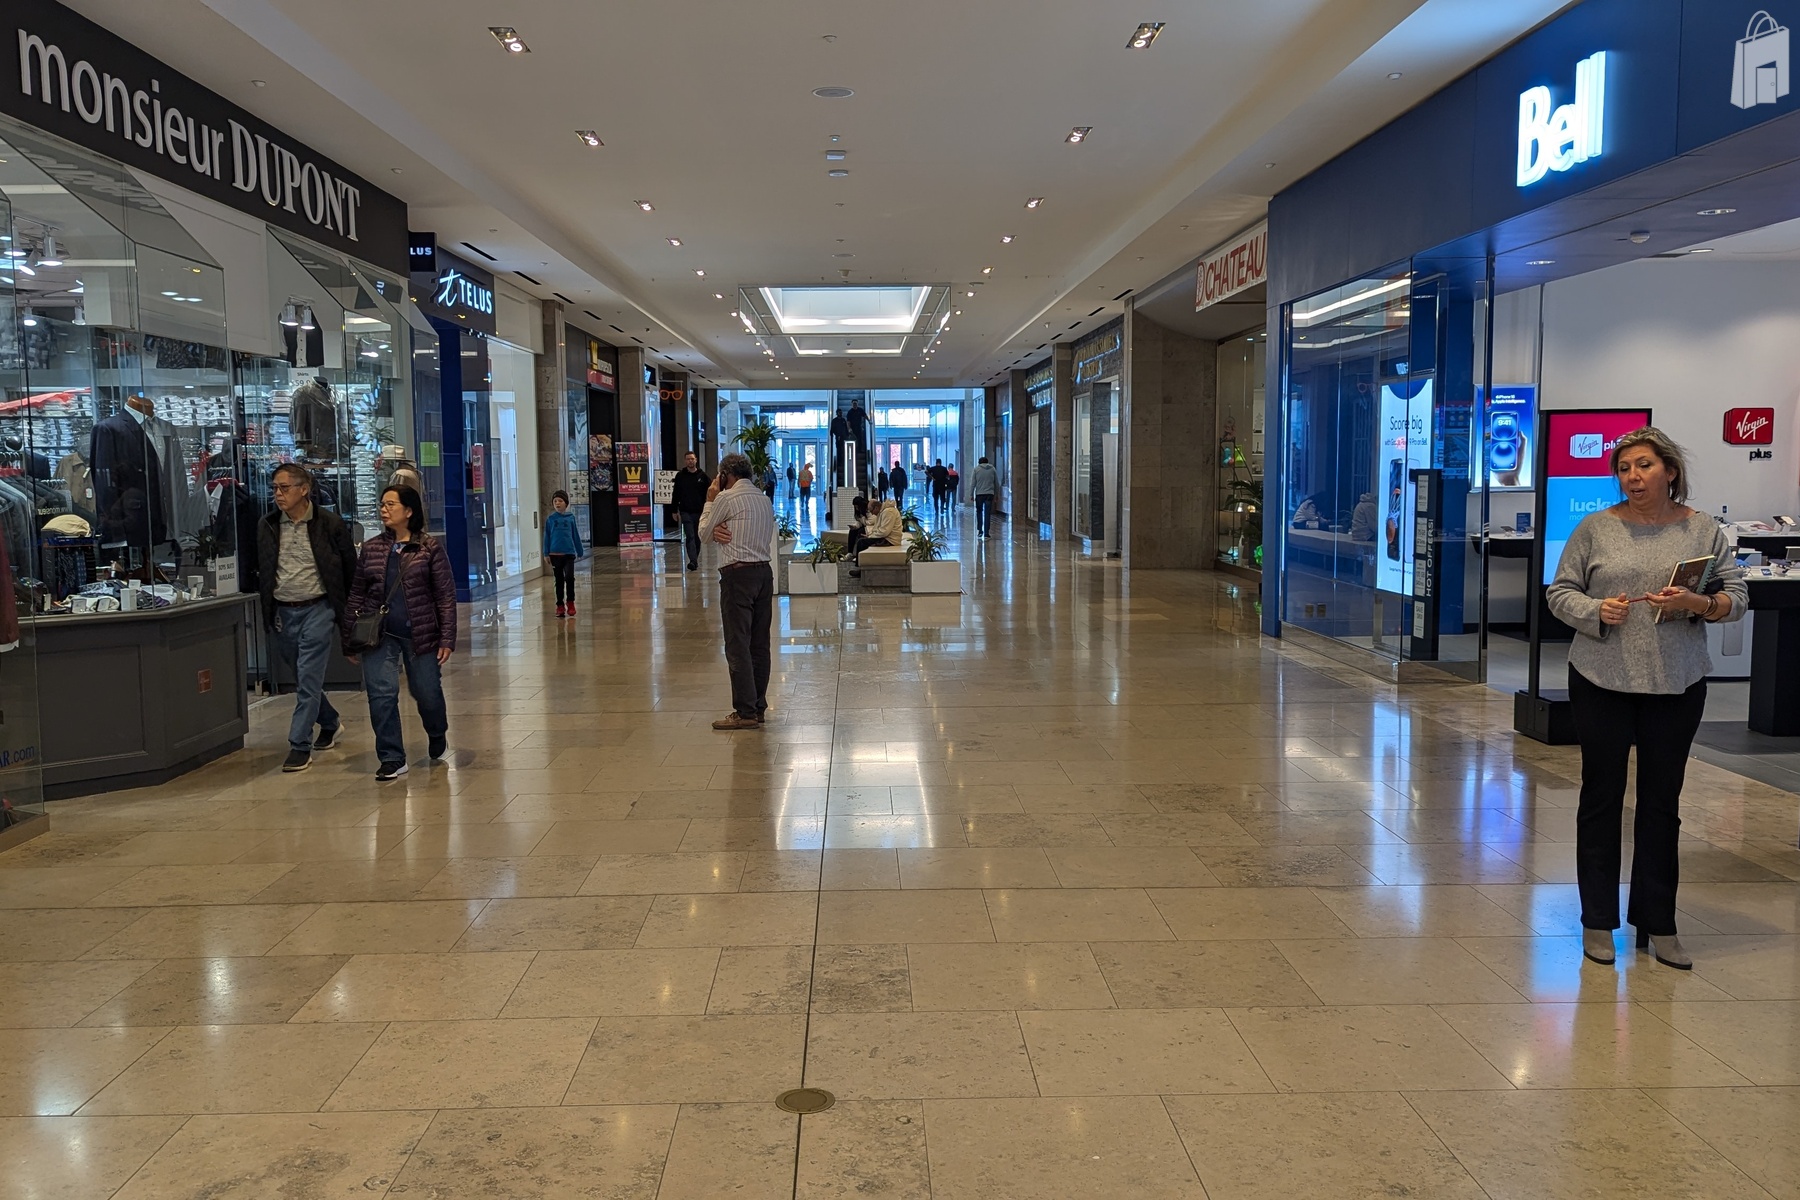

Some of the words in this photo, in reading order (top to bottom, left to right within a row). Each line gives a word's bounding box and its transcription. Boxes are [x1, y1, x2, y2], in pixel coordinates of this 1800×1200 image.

[1516, 50, 1607, 187] Bell
[18, 28, 224, 181] monsieur
[228, 118, 361, 243] DUPONT
[459, 278, 492, 315] TELUS
[1411, 414, 1422, 434] big
[1736, 411, 1769, 440] Virgin
[1578, 436, 1599, 455] Virgin
[1749, 448, 1772, 462] plus
[1570, 498, 1617, 512] luck
